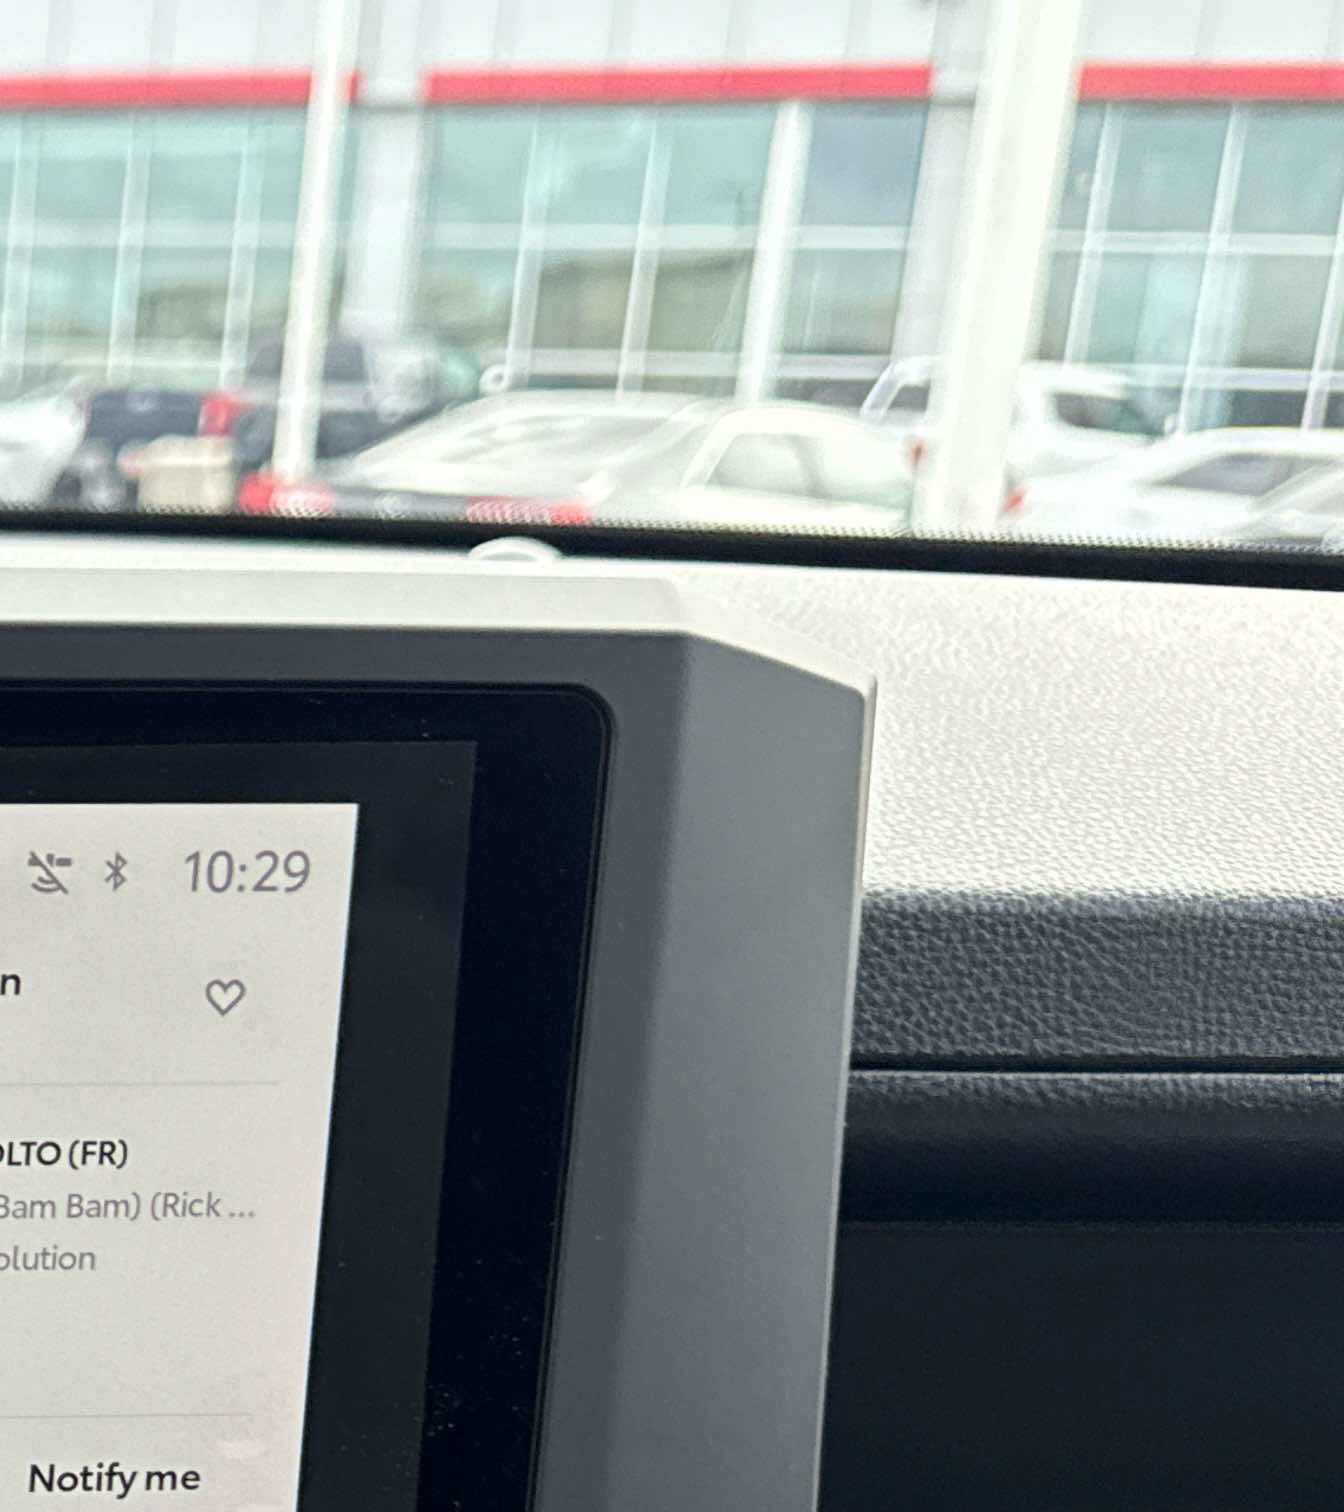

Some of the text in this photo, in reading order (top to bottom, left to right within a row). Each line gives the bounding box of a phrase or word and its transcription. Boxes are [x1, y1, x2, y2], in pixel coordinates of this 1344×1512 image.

[184, 851, 310, 893] 10:29
[69, 1139, 128, 1170] (FR)
[66, 1192, 141, 1222] Bam)
[151, 1192, 222, 1221] (Rick
[27, 1463, 201, 1500] Notify me
